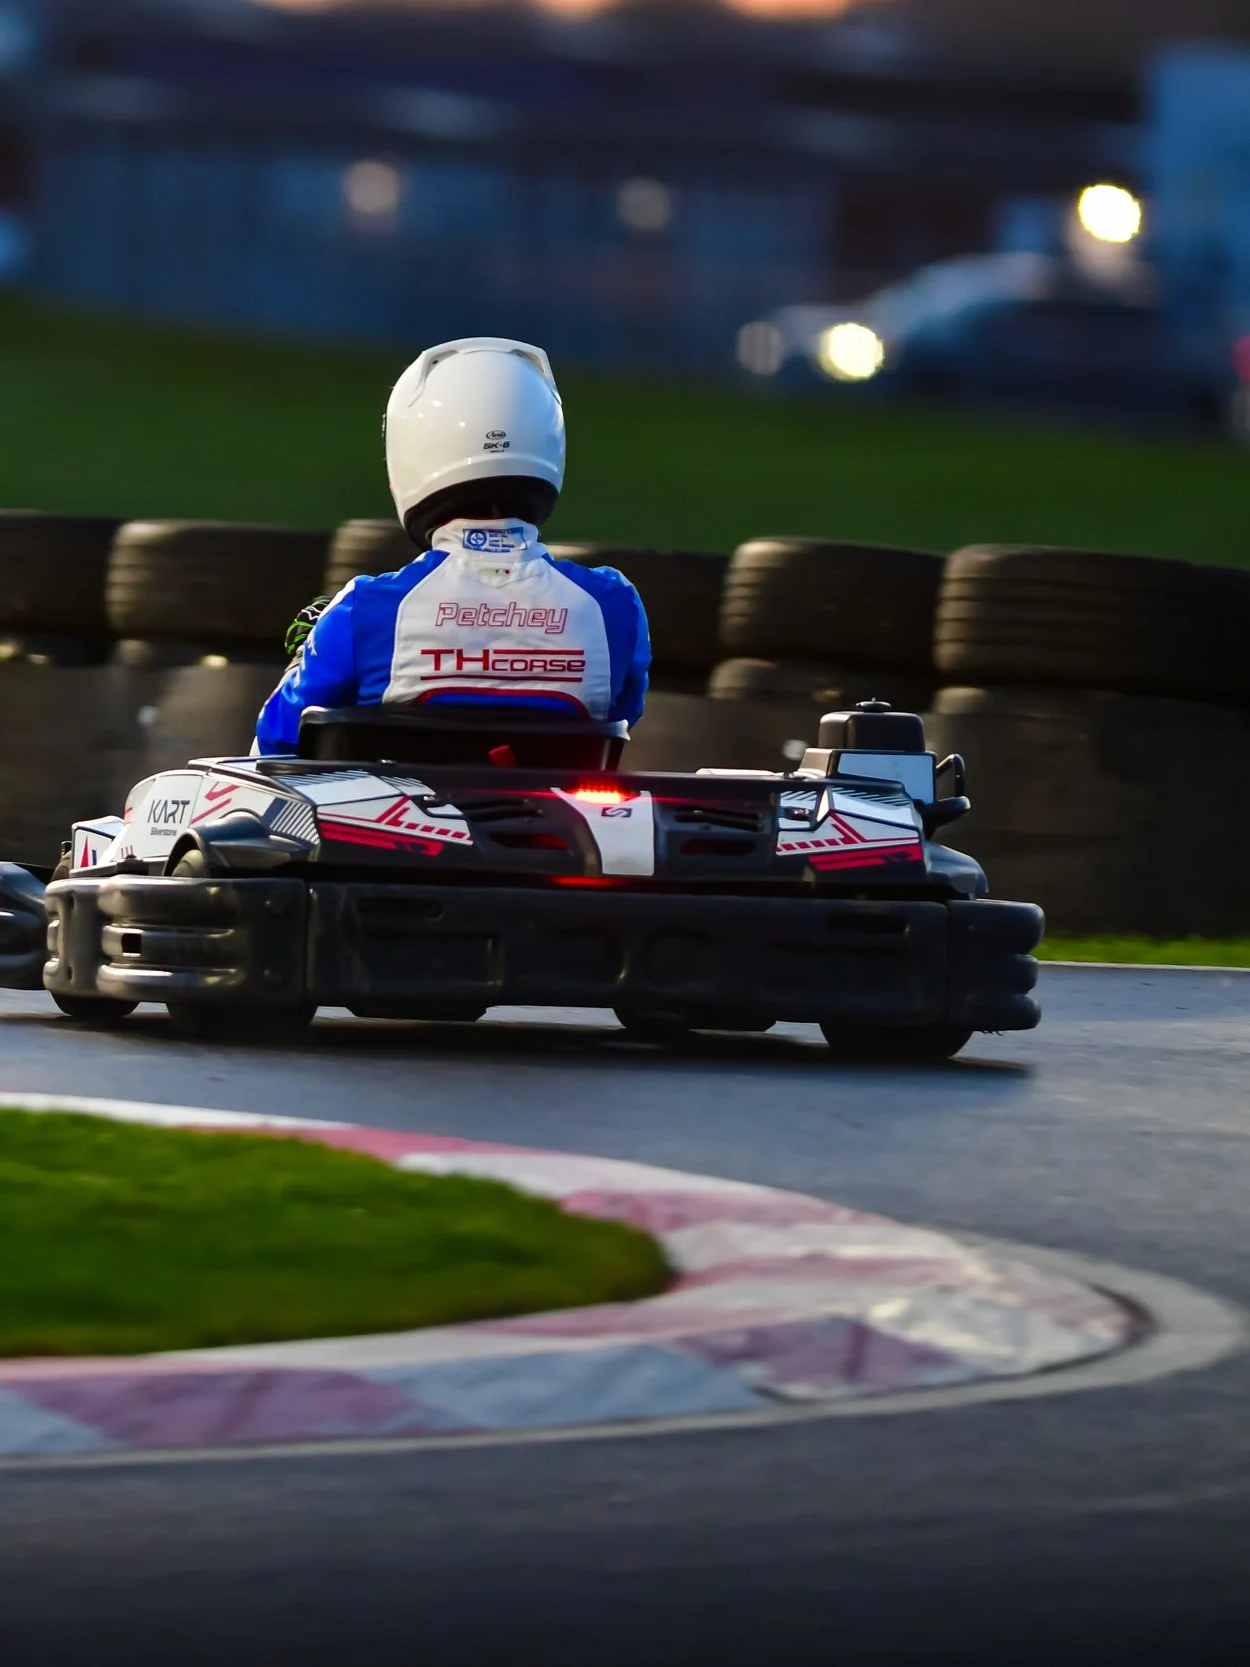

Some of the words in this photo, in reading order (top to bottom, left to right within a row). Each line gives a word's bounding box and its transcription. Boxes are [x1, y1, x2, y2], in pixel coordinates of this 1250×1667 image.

[483, 441, 510, 449] SK-6
[435, 601, 568, 634] Petchey
[147, 799, 191, 824] KART
